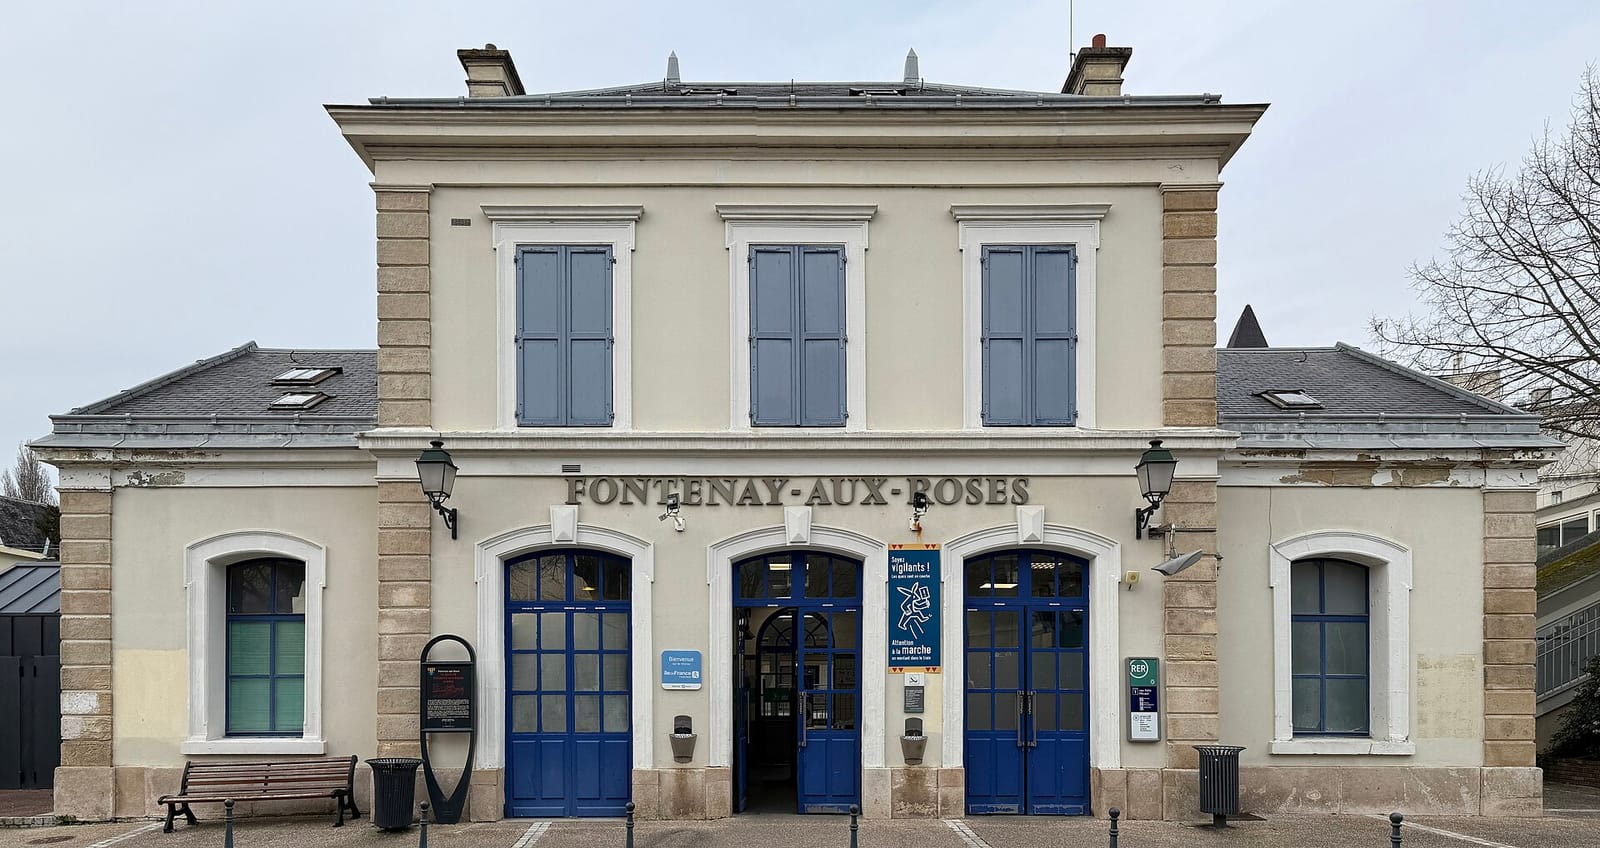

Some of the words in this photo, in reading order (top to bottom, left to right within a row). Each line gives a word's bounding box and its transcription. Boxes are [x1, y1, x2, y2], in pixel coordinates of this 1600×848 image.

[564, 476, 1030, 507] FONTENAY-AUX-ROSES
[891, 562, 925, 574] vigilants
[902, 644, 932, 655] marche
[1131, 664, 1146, 673] RER
